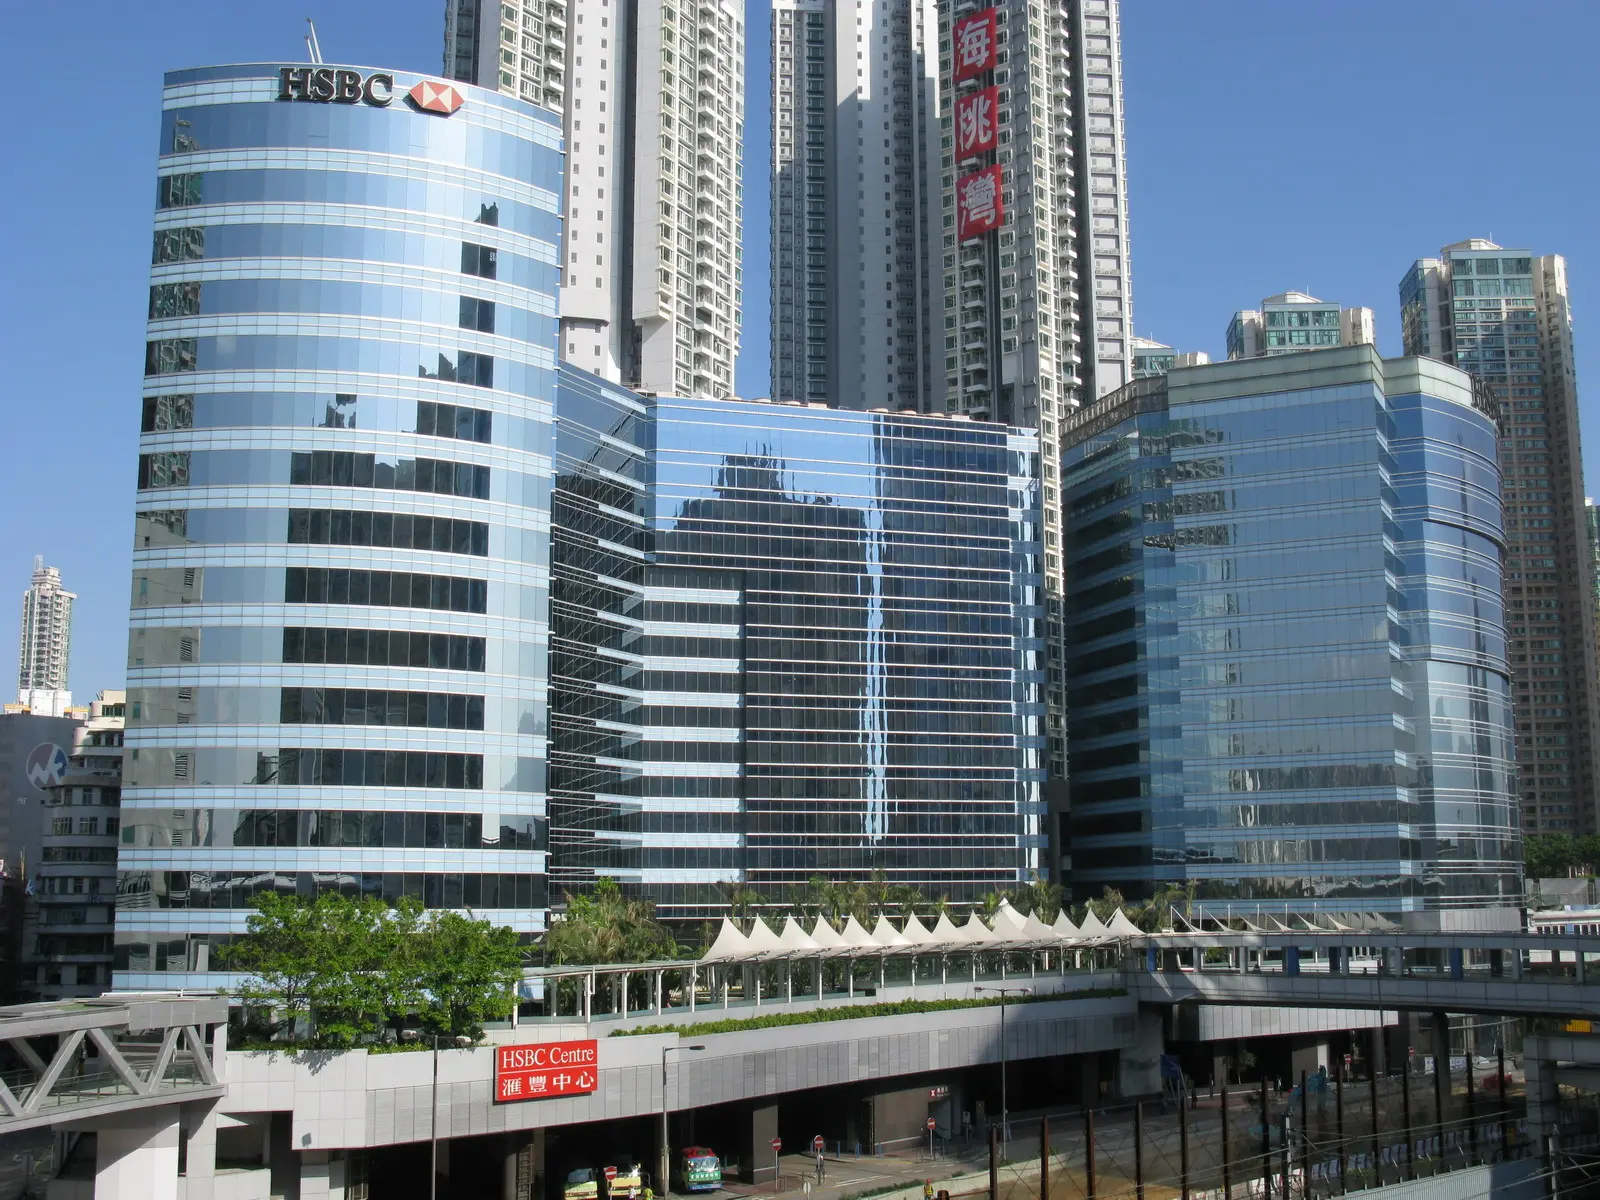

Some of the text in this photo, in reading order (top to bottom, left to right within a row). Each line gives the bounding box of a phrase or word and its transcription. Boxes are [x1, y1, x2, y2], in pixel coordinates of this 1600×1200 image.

[279, 67, 394, 107] HSBC
[956, 18, 996, 235] 海桃灣
[502, 1047, 594, 1069] HSBC Centre
